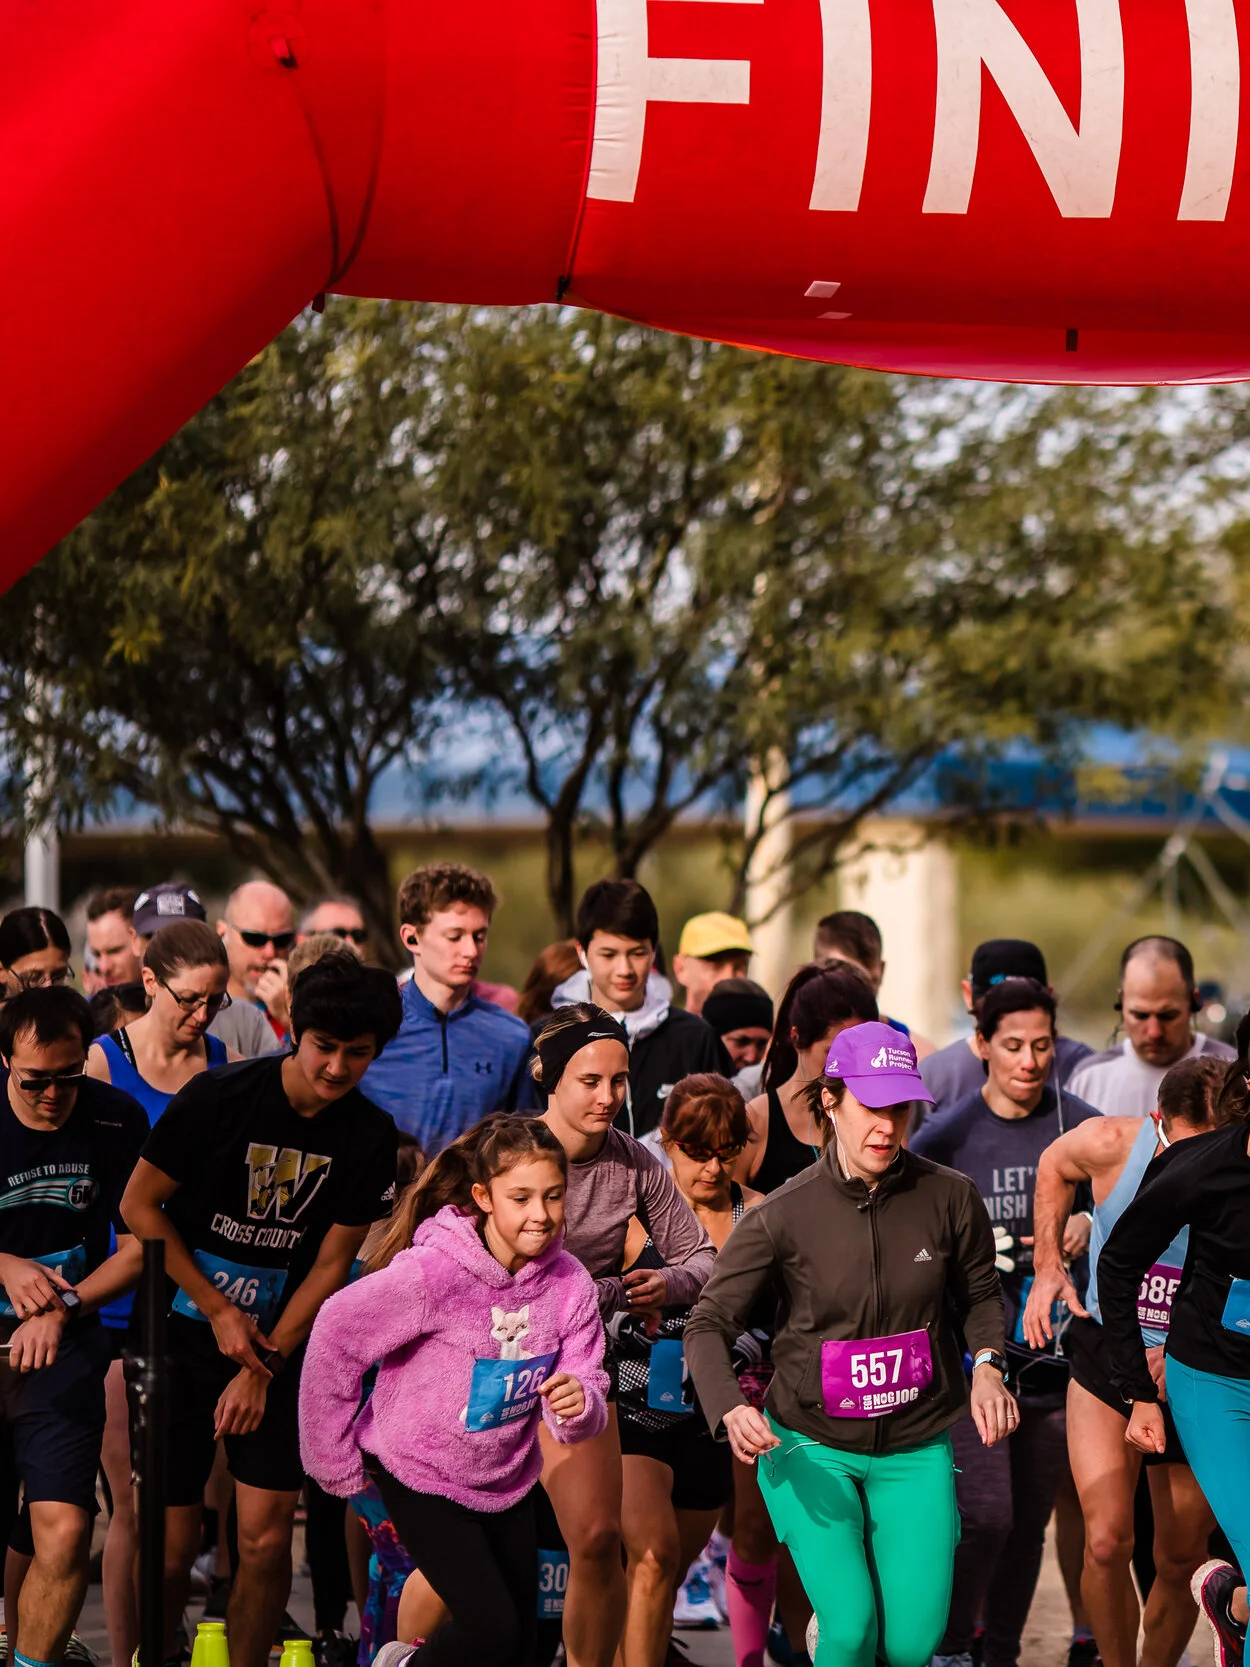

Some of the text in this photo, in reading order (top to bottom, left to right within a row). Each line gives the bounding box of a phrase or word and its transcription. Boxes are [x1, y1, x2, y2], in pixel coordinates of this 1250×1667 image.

[887, 1047, 911, 1058] Tucson
[8, 1163, 90, 1188] REFUSE TO ABUSE
[245, 1142, 333, 1223] W
[993, 1166, 1037, 1193] LET'
[71, 1185, 96, 1205] 5K
[211, 1213, 308, 1250] CROSS COUNT
[213, 1271, 260, 1307] 246
[504, 1366, 547, 1402] 126
[851, 1348, 903, 1389] 557
